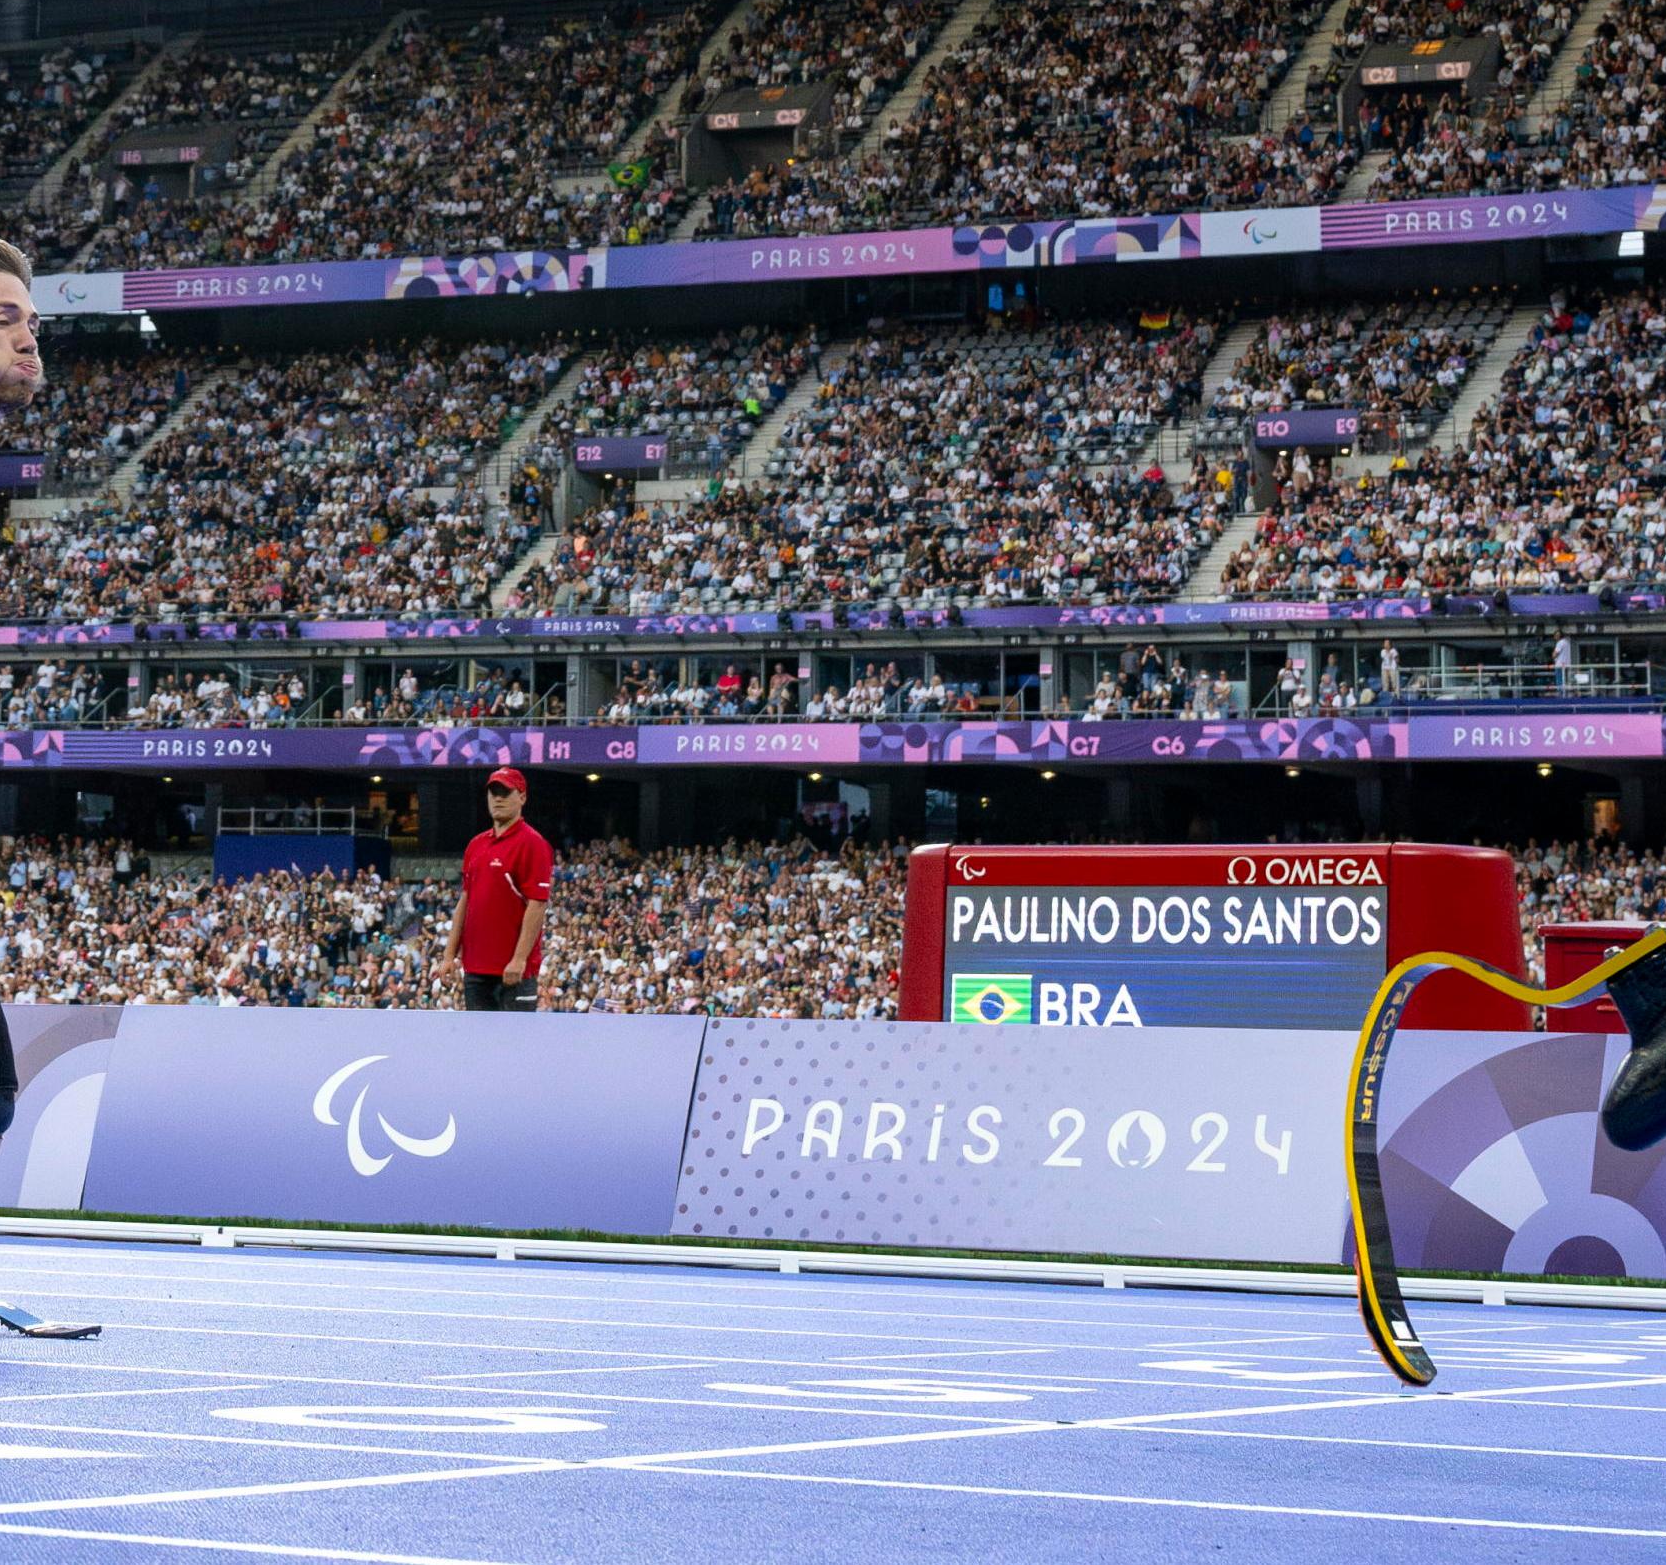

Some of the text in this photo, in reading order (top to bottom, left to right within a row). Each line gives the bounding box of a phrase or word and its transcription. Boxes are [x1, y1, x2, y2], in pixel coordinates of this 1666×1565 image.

[1385, 201, 1567, 234] PARIS 2024
[751, 243, 915, 270] PARIS 2024
[176, 274, 323, 299] PARIS 2024
[1256, 418, 1358, 438] E10 E9
[577, 445, 602, 461] E12
[544, 620, 621, 632] PARIS 2024
[676, 733, 820, 753] PARIS 2024
[1069, 735, 1101, 756] G7
[1151, 735, 1185, 756] G6
[1453, 725, 1614, 747] PARIS 2024
[143, 739, 272, 758] PARIS 2024
[548, 740, 571, 760] H1
[605, 740, 636, 761] G8
[1265, 858, 1383, 885] OMEGA
[953, 895, 1381, 946] PAULINO DOS SANTOS
[1039, 982, 1143, 1028] BRA
[741, 1098, 1293, 1175] PARIS 2024
